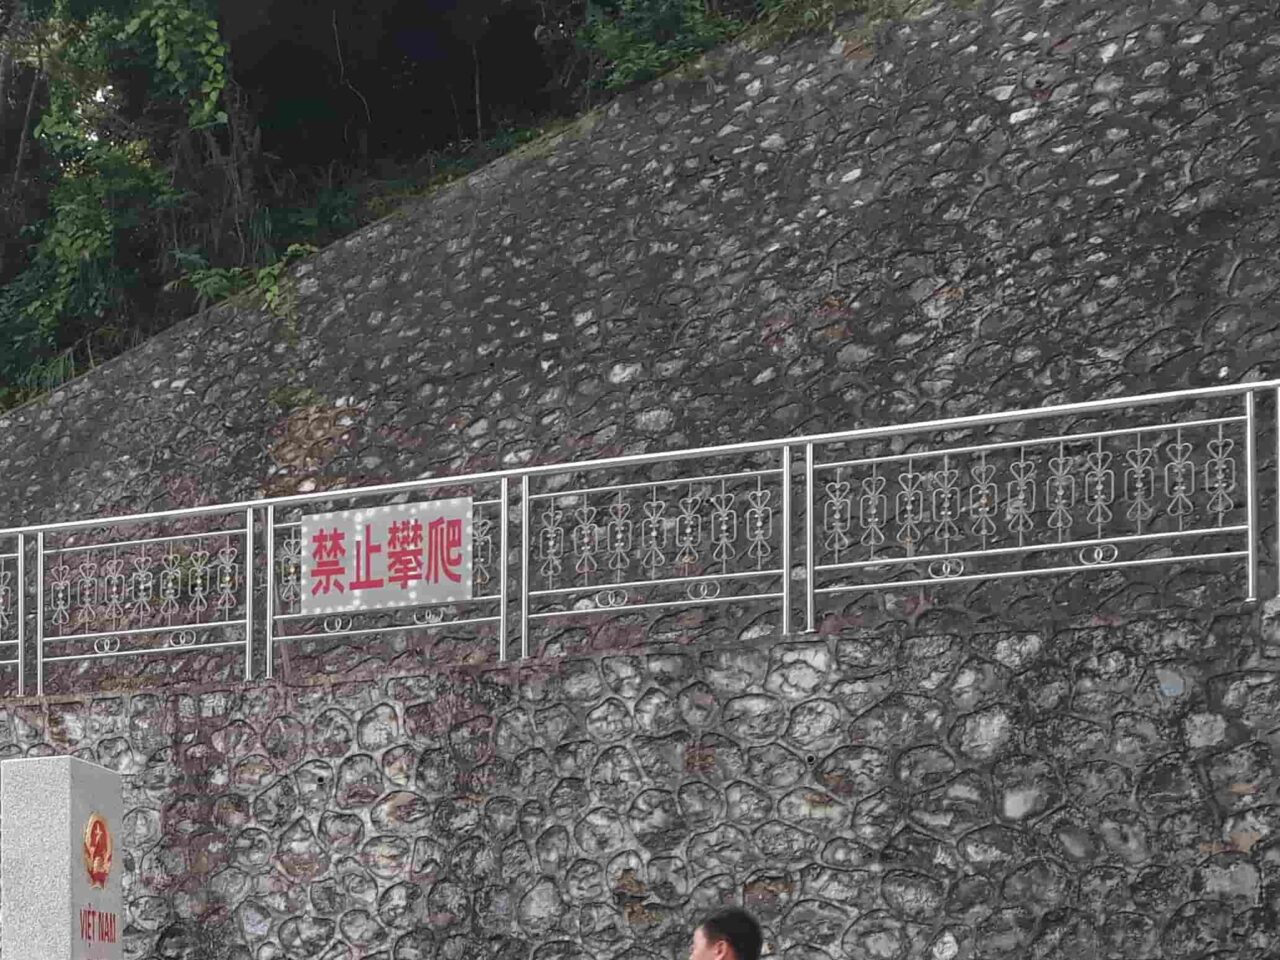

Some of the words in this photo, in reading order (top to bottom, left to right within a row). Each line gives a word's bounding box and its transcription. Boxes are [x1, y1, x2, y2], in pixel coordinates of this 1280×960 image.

[311, 517, 462, 596] 禁止攀爬
[80, 903, 97, 948] VIỆT
[98, 910, 117, 944] NAM
